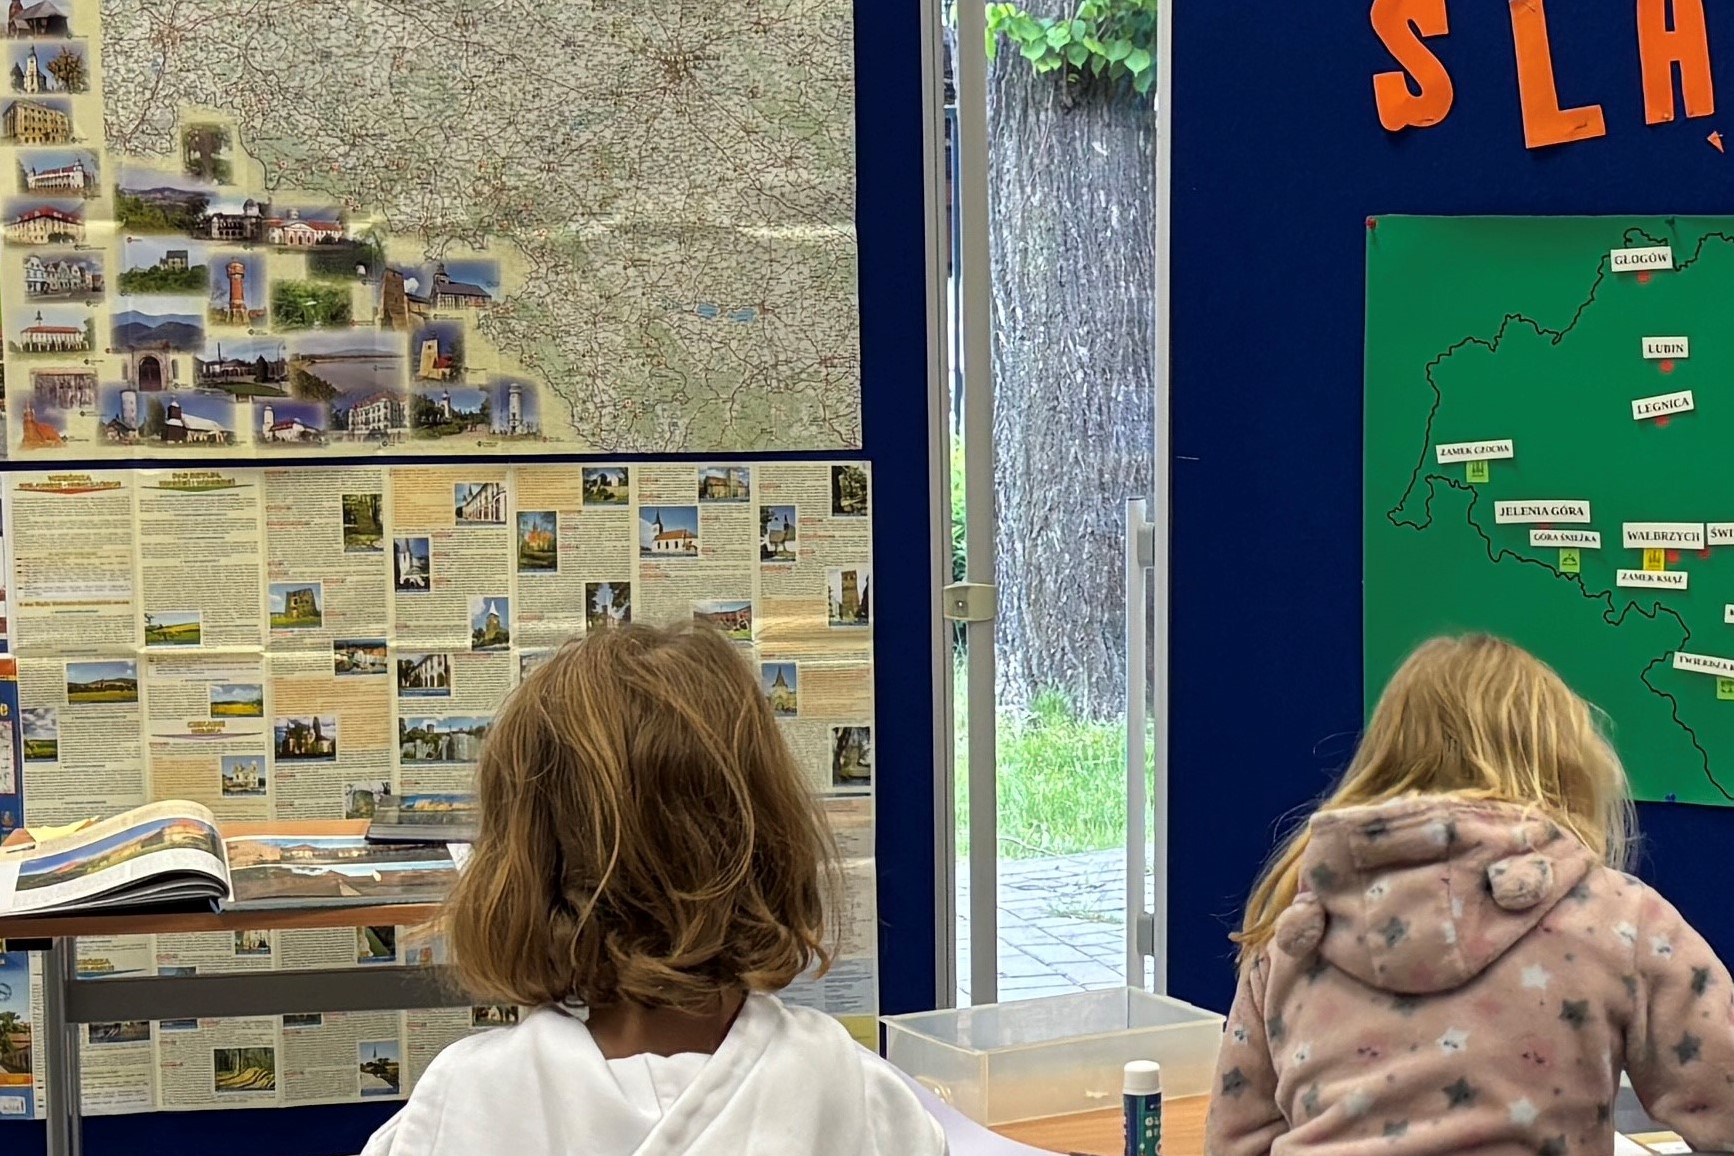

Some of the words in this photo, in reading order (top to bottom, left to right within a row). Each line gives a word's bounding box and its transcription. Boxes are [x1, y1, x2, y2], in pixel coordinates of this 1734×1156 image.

[1648, 344, 1684, 354] LUBIN
[1637, 396, 1690, 415] LEGNICA
[1499, 506, 1549, 517] JELENIA
[1551, 504, 1584, 516] GÓRA
